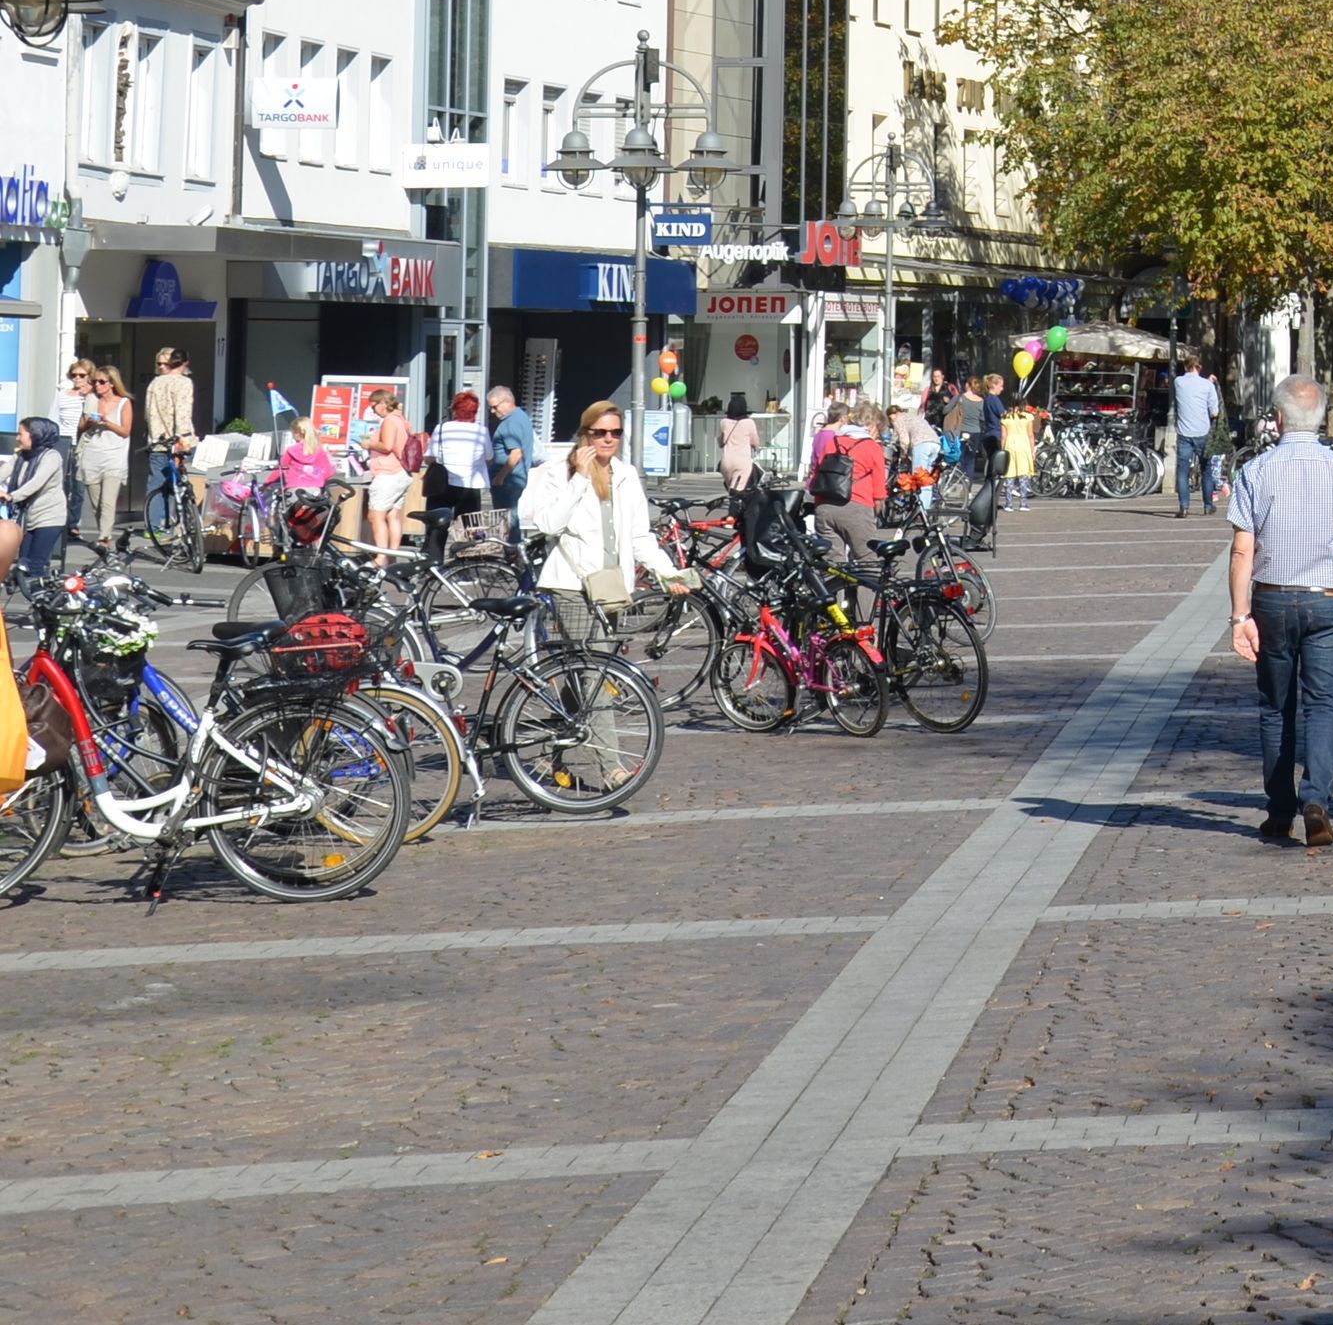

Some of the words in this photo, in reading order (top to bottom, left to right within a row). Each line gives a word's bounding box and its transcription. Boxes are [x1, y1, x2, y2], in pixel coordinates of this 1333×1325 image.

[258, 113, 329, 123] TARGOBANK
[433, 159, 484, 171] unique
[656, 223, 706, 237] KIND
[700, 241, 790, 265] Augenoptik
[390, 256, 436, 298] BANK
[597, 263, 636, 303] KIN
[707, 296, 785, 314] JONEN
